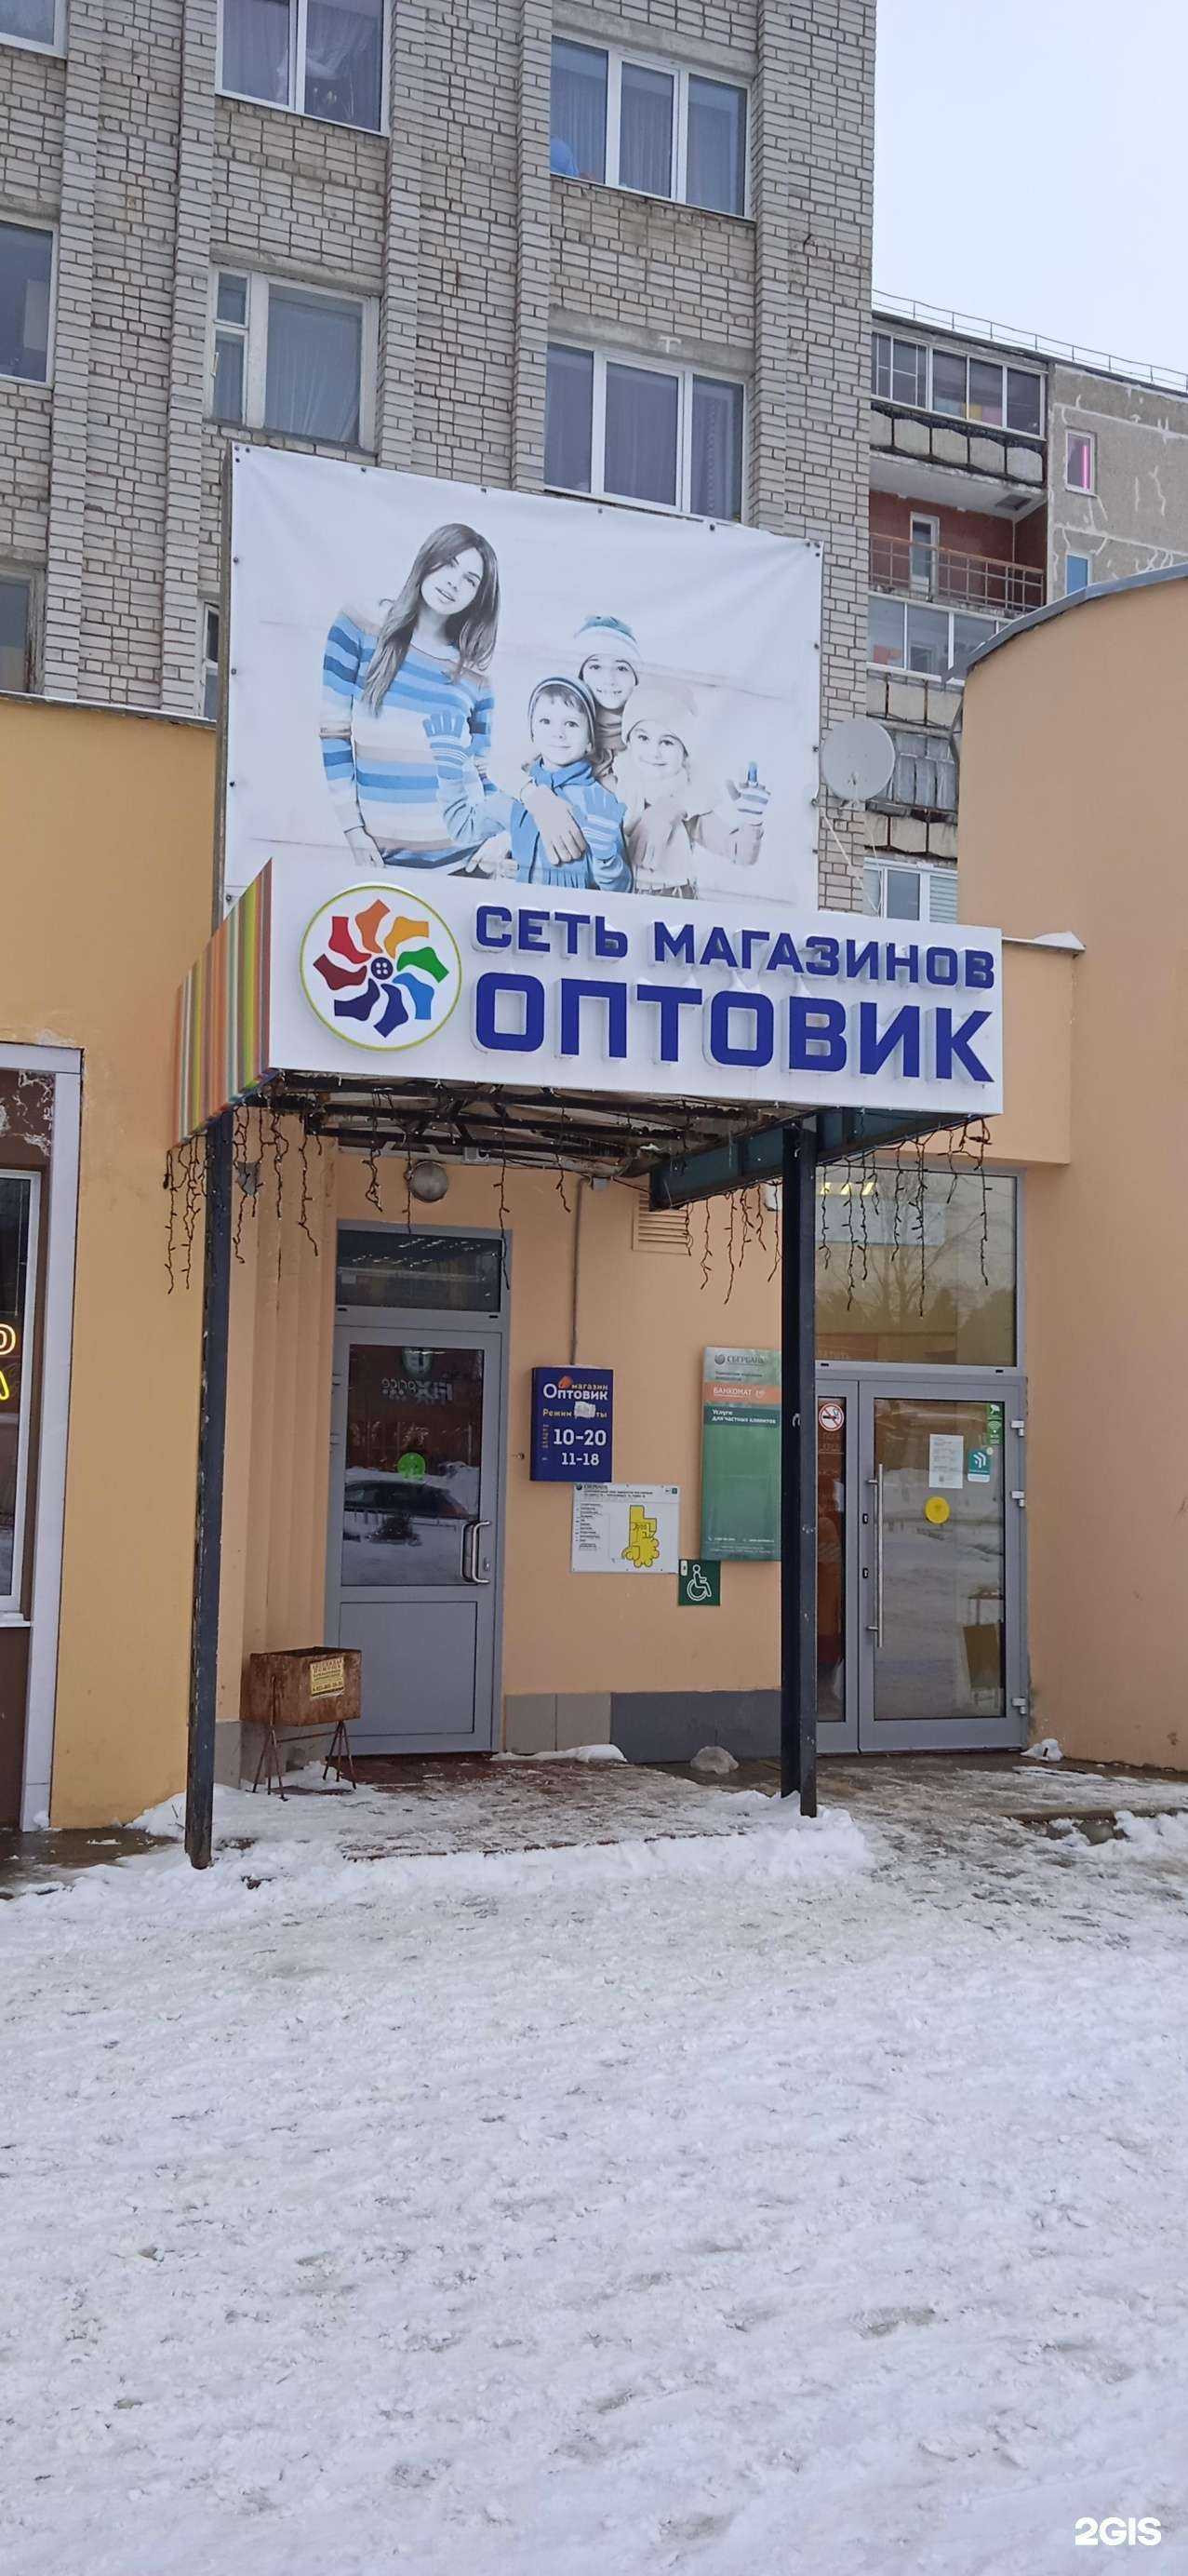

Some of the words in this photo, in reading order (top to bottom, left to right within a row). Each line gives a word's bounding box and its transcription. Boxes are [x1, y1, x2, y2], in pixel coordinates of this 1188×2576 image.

[475, 905, 629, 958] СЕТЬ
[654, 920, 995, 989] МАГАЗИНОВ
[475, 972, 995, 1083] ОПТОВИК
[542, 1408, 572, 1417] Режим
[554, 1429, 607, 1446] 10-20
[561, 1452, 600, 1467] 11-18
